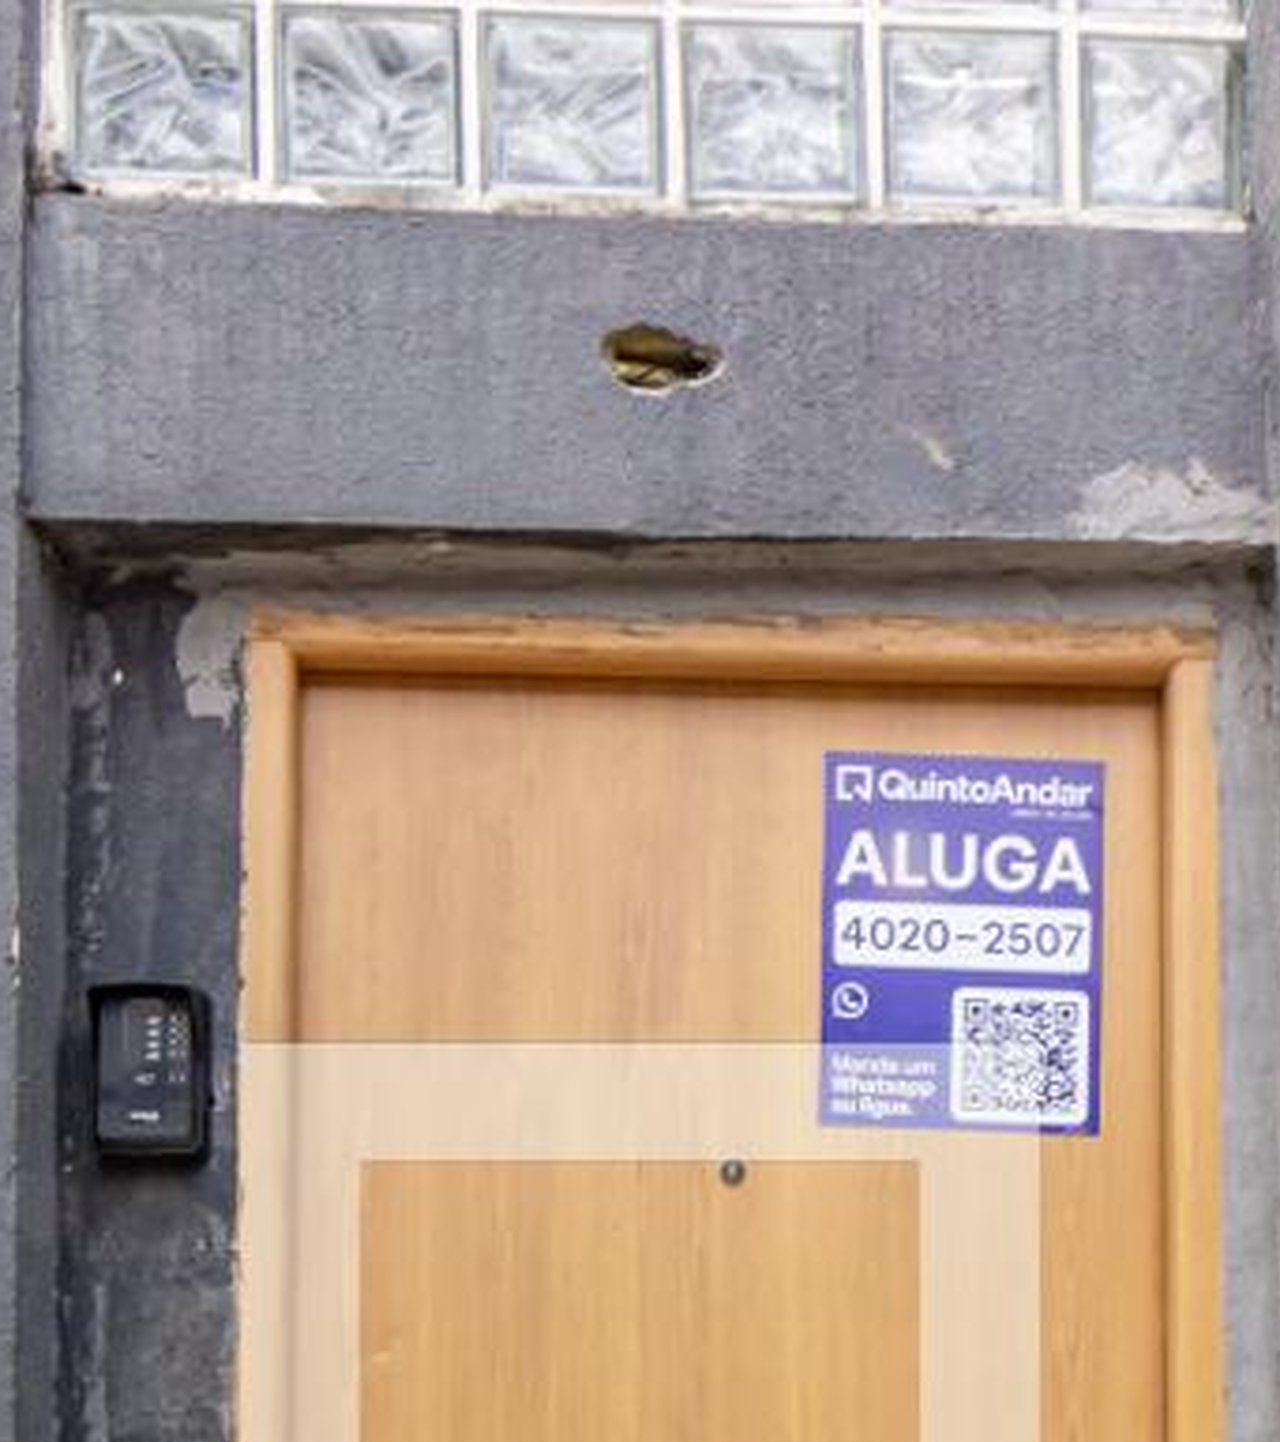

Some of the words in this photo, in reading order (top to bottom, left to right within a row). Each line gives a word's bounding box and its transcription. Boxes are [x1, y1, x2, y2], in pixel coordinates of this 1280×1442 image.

[878, 769, 1093, 807] QuintoAndar
[835, 829, 1091, 894] ALUGA
[842, 917, 1084, 957] 4020-2507
